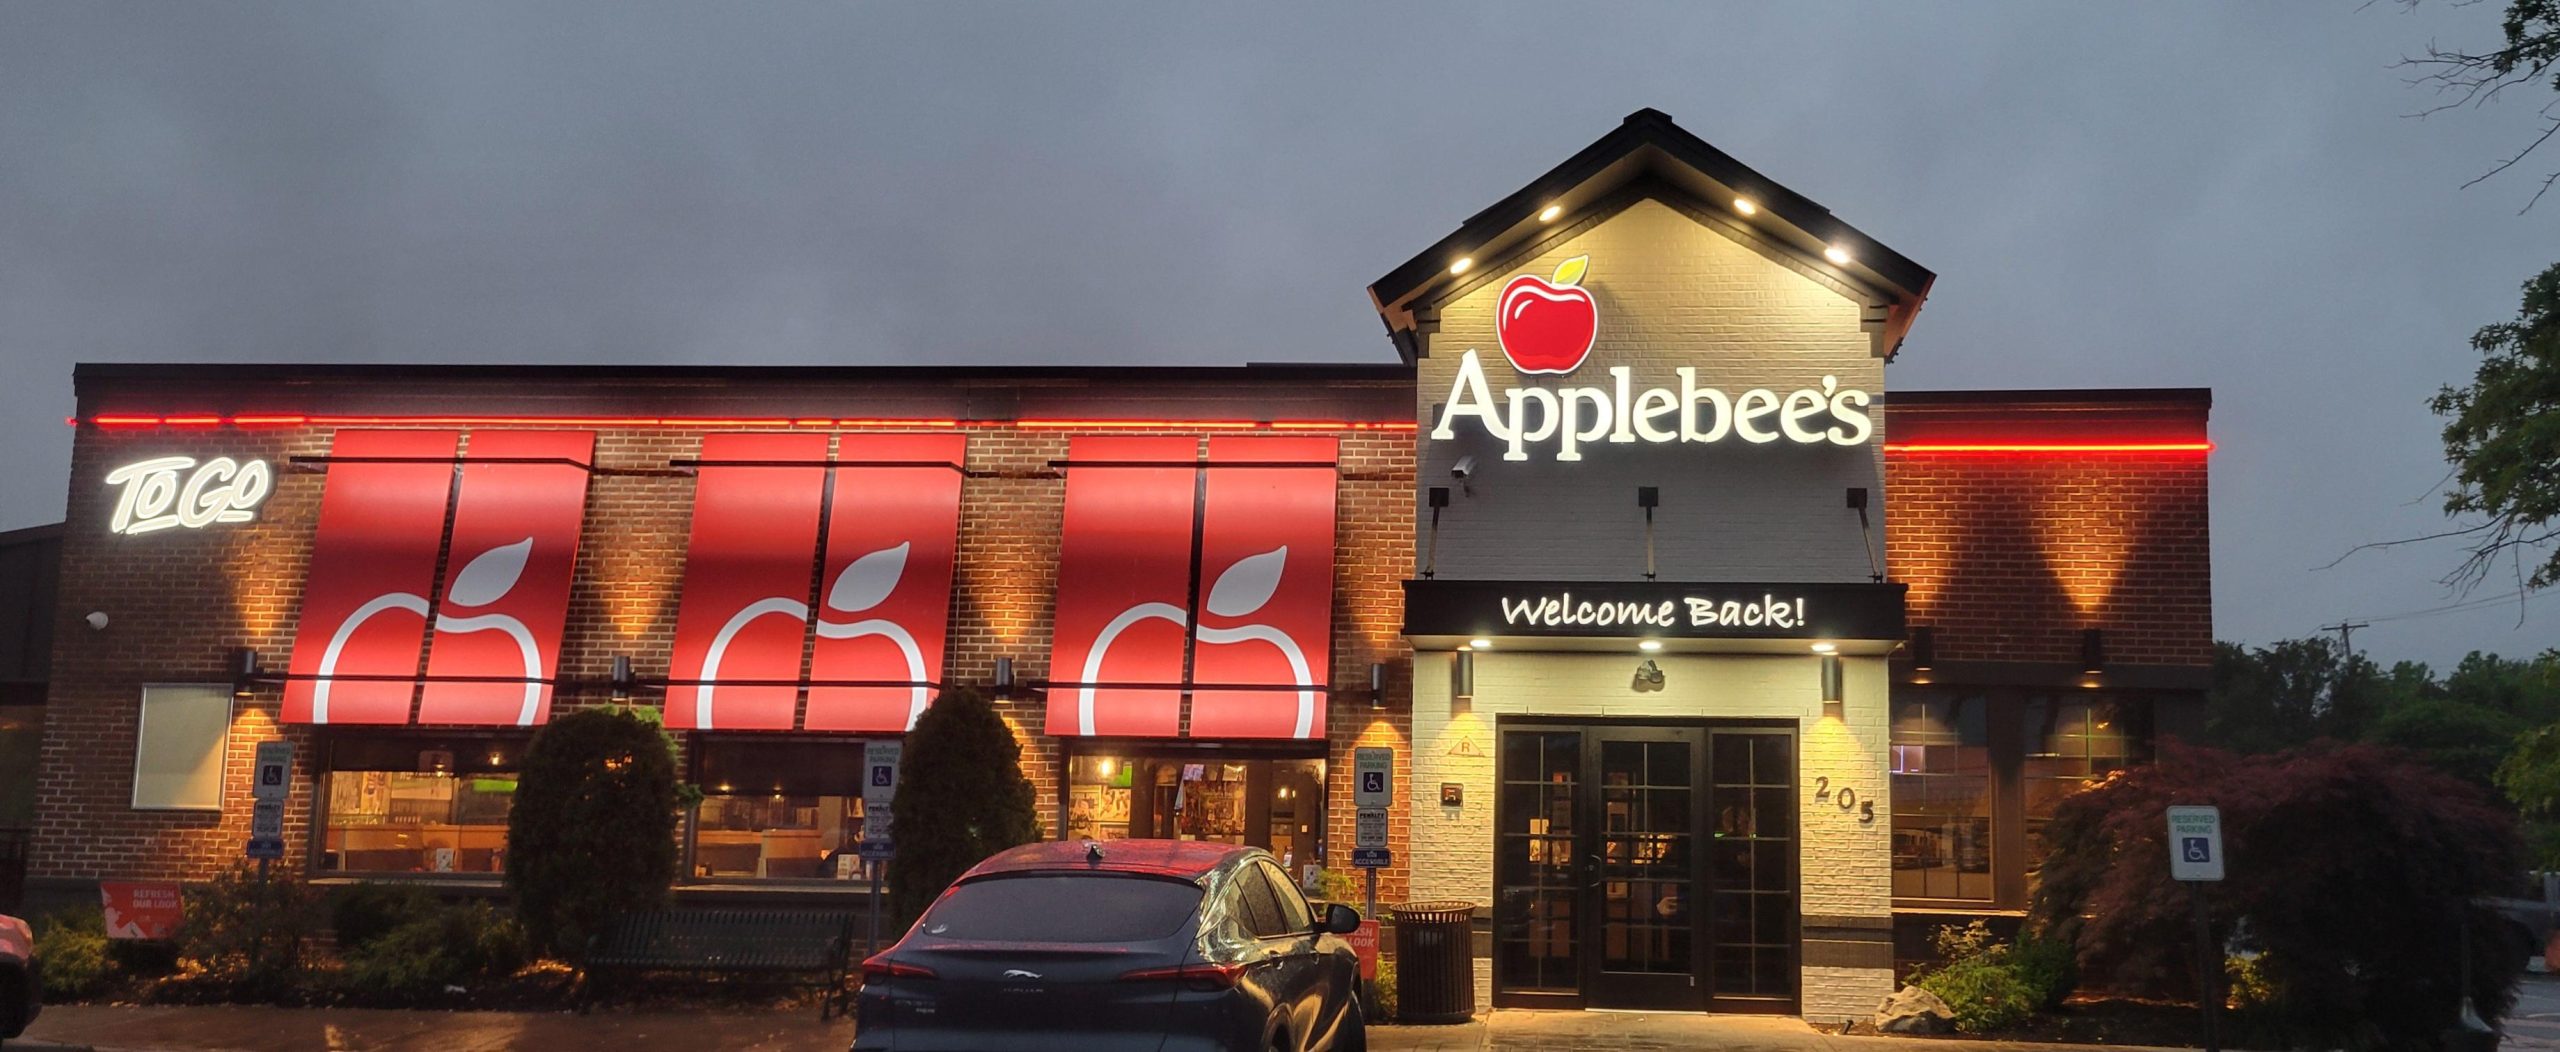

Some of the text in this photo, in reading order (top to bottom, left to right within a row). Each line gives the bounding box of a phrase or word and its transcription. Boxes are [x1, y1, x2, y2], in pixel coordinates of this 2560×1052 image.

[1431, 348, 1872, 462] Applebee's
[1501, 592, 1806, 629] Welcome Back!
[1461, 741, 1471, 753] R
[2171, 815, 2216, 824] RESERVED
[2176, 825, 2213, 834] PARKING
[133, 889, 176, 898] REFRESH
[132, 900, 178, 908] OUR LOOK
